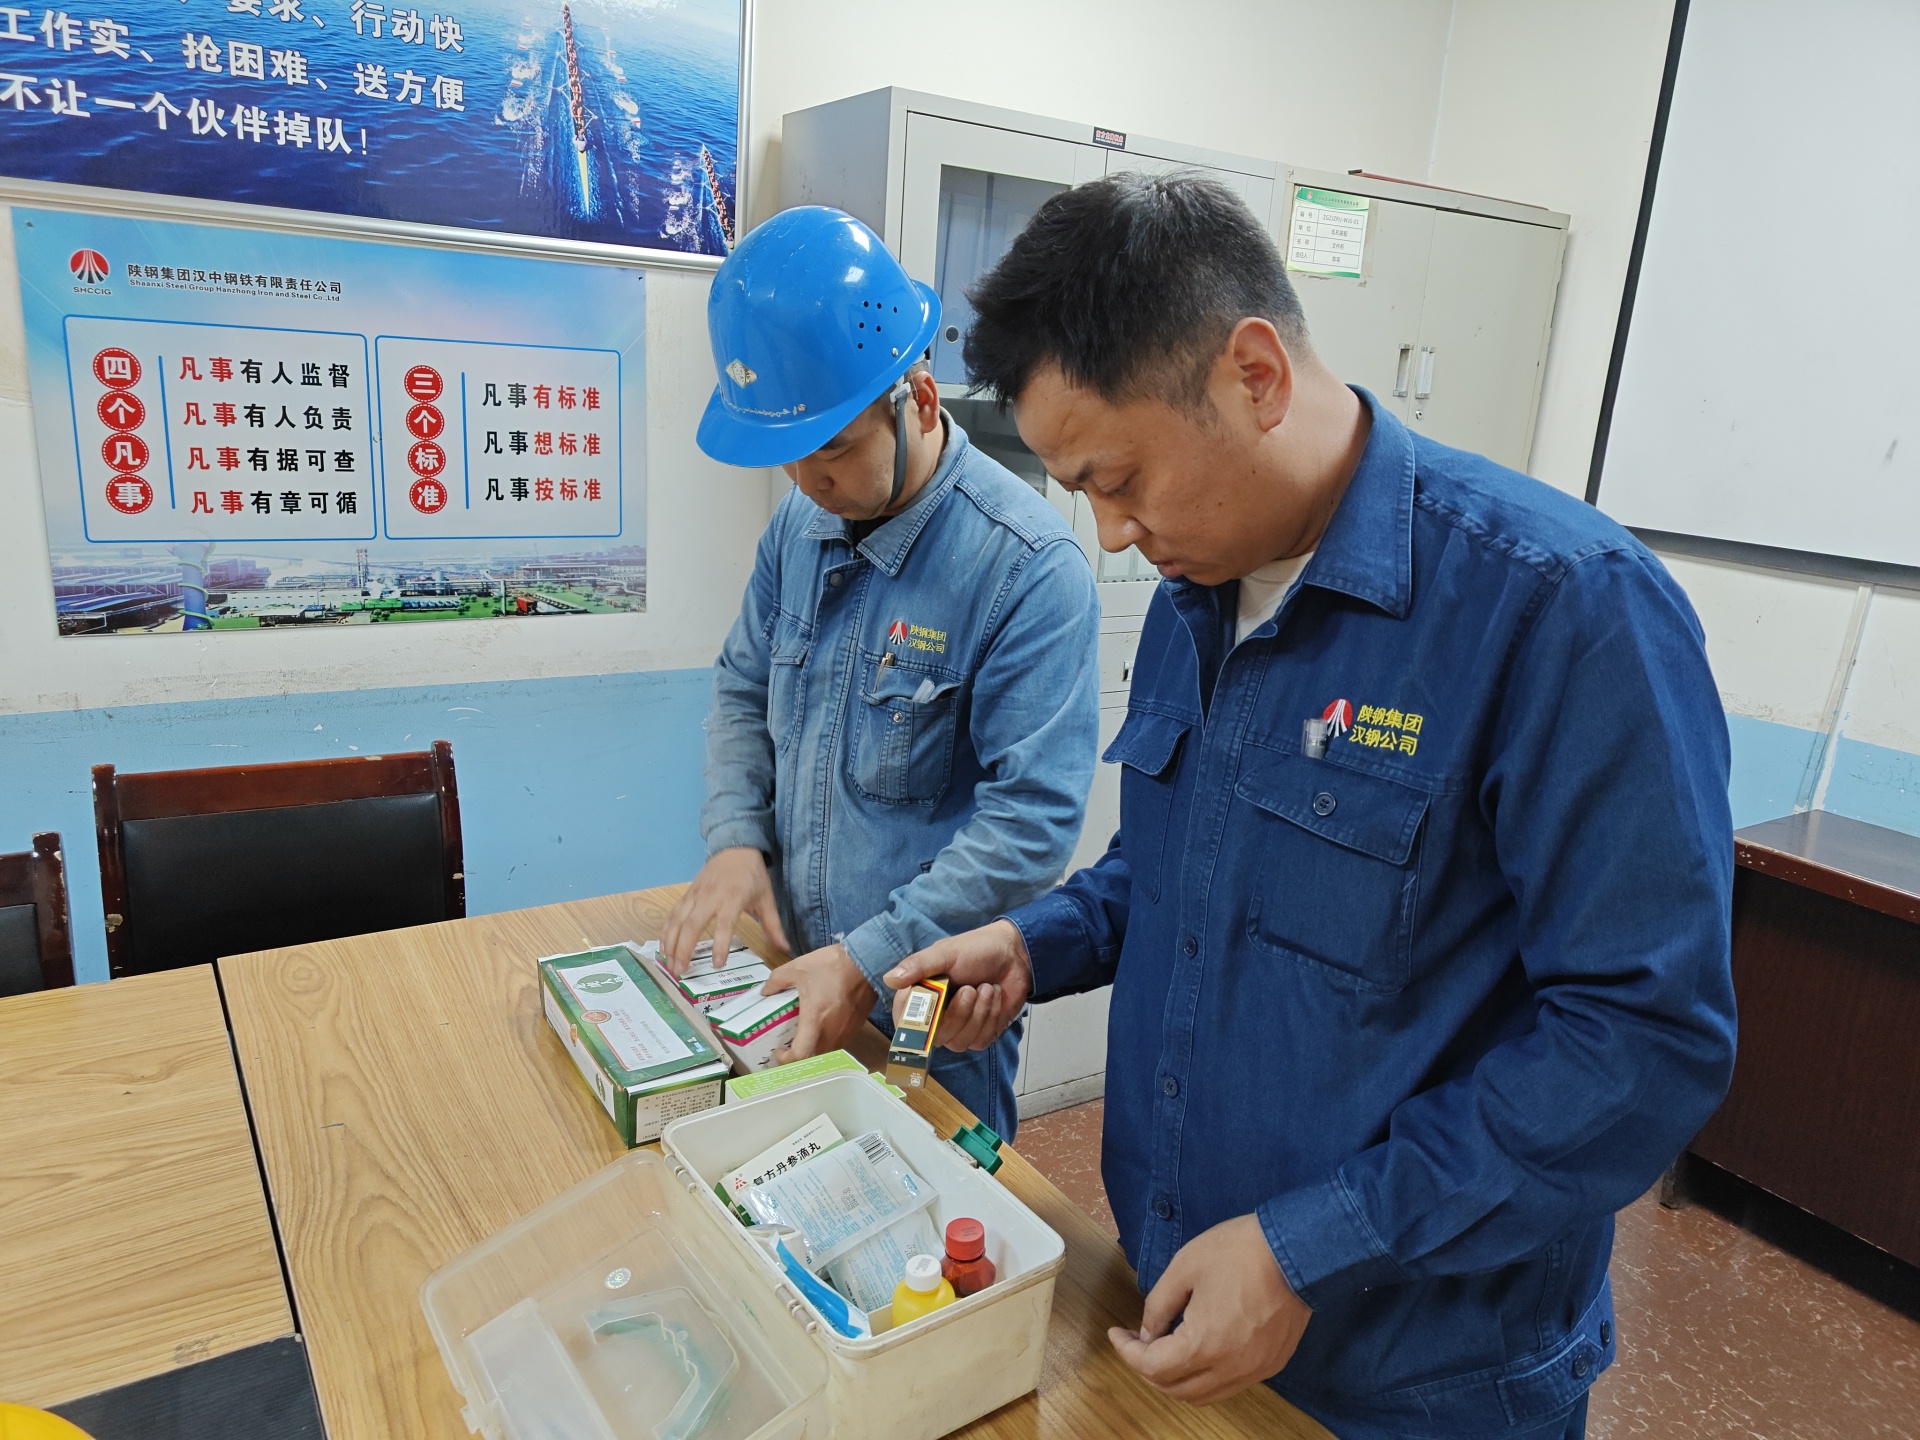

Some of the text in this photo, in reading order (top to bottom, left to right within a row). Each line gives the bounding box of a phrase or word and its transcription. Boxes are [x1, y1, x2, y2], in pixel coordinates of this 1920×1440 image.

[73, 286, 112, 296] SHCCIG
[127, 264, 342, 294] 陕钢集团汉中钢铁有限责任公司
[130, 279, 164, 288] Shaanxi
[165, 282, 187, 290] Steel
[189, 284, 215, 293] Group
[216, 286, 256, 296] Hanzhong
[291, 292, 311, 300] Steel
[180, 356, 350, 389] 凡事有人监督
[482, 382, 602, 410] 凡事有标准
[184, 402, 353, 432] 凡事有人负责
[103, 357, 146, 508] 四个凡事
[413, 372, 440, 508] 三个标准
[483, 431, 602, 457] 凡事想标准
[187, 447, 356, 475] 凡事有据可查
[191, 490, 358, 516] 凡事有章可循
[484, 478, 602, 503] 凡事按标准
[908, 638, 945, 654] 汉钢公司
[910, 624, 946, 642] 陕钢集团
[1357, 704, 1424, 735] 陕钢集团
[1349, 724, 1418, 757] 汉钢公司
[753, 1142, 821, 1186] 复方丹参滴丸
